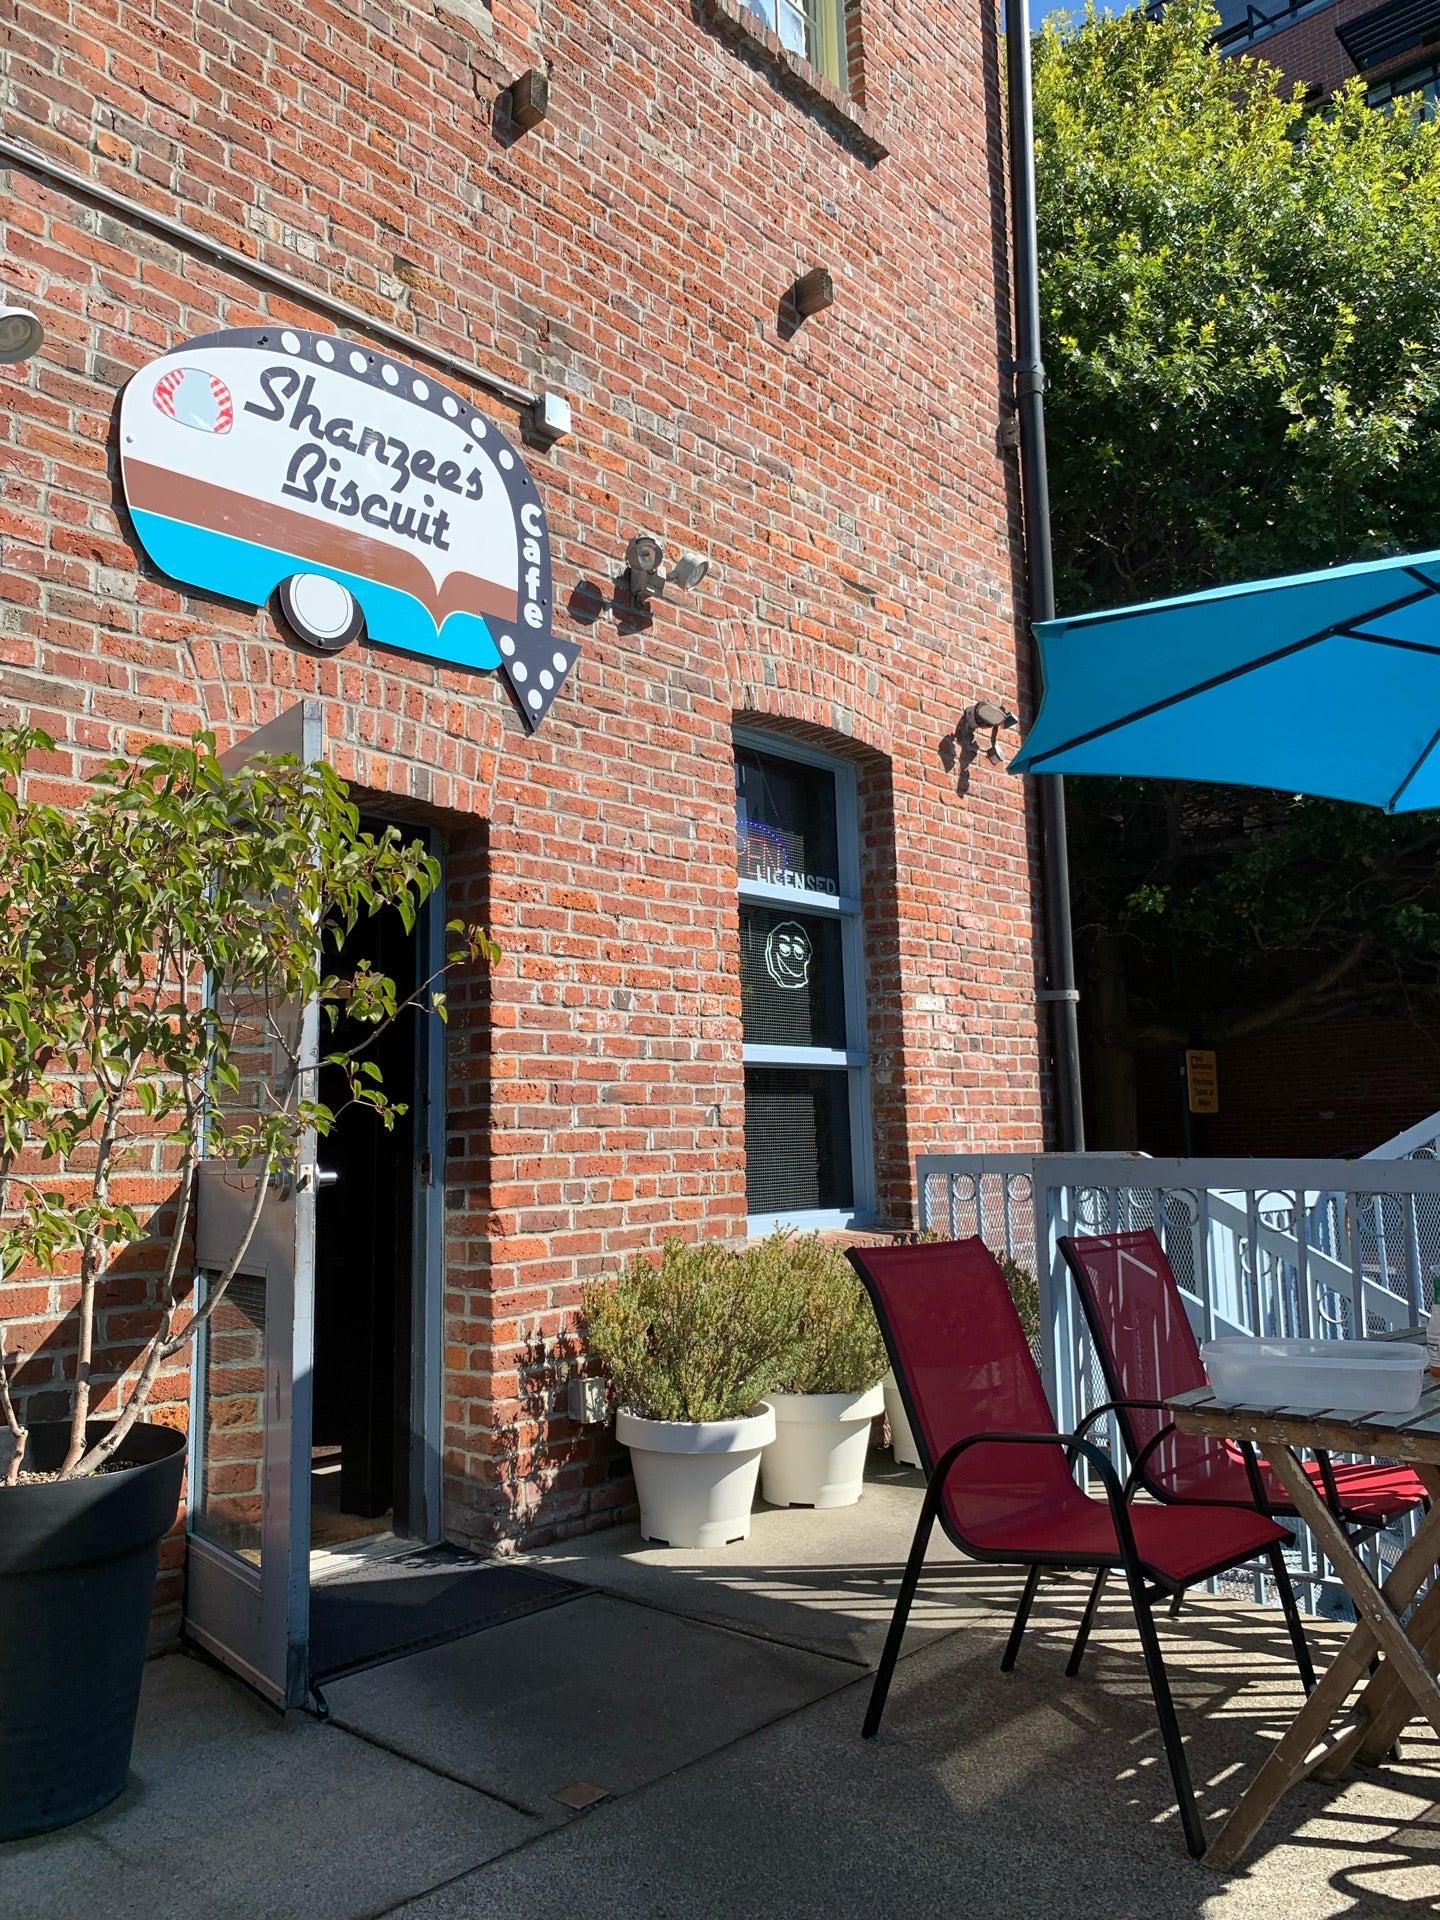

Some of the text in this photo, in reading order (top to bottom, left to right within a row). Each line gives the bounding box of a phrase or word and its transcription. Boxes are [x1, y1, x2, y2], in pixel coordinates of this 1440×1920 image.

[244, 366, 484, 501] Shanzee's
[281, 442, 450, 551] Biscuit
[520, 503, 543, 629] Cafe
[757, 865, 836, 894] LICENSED
